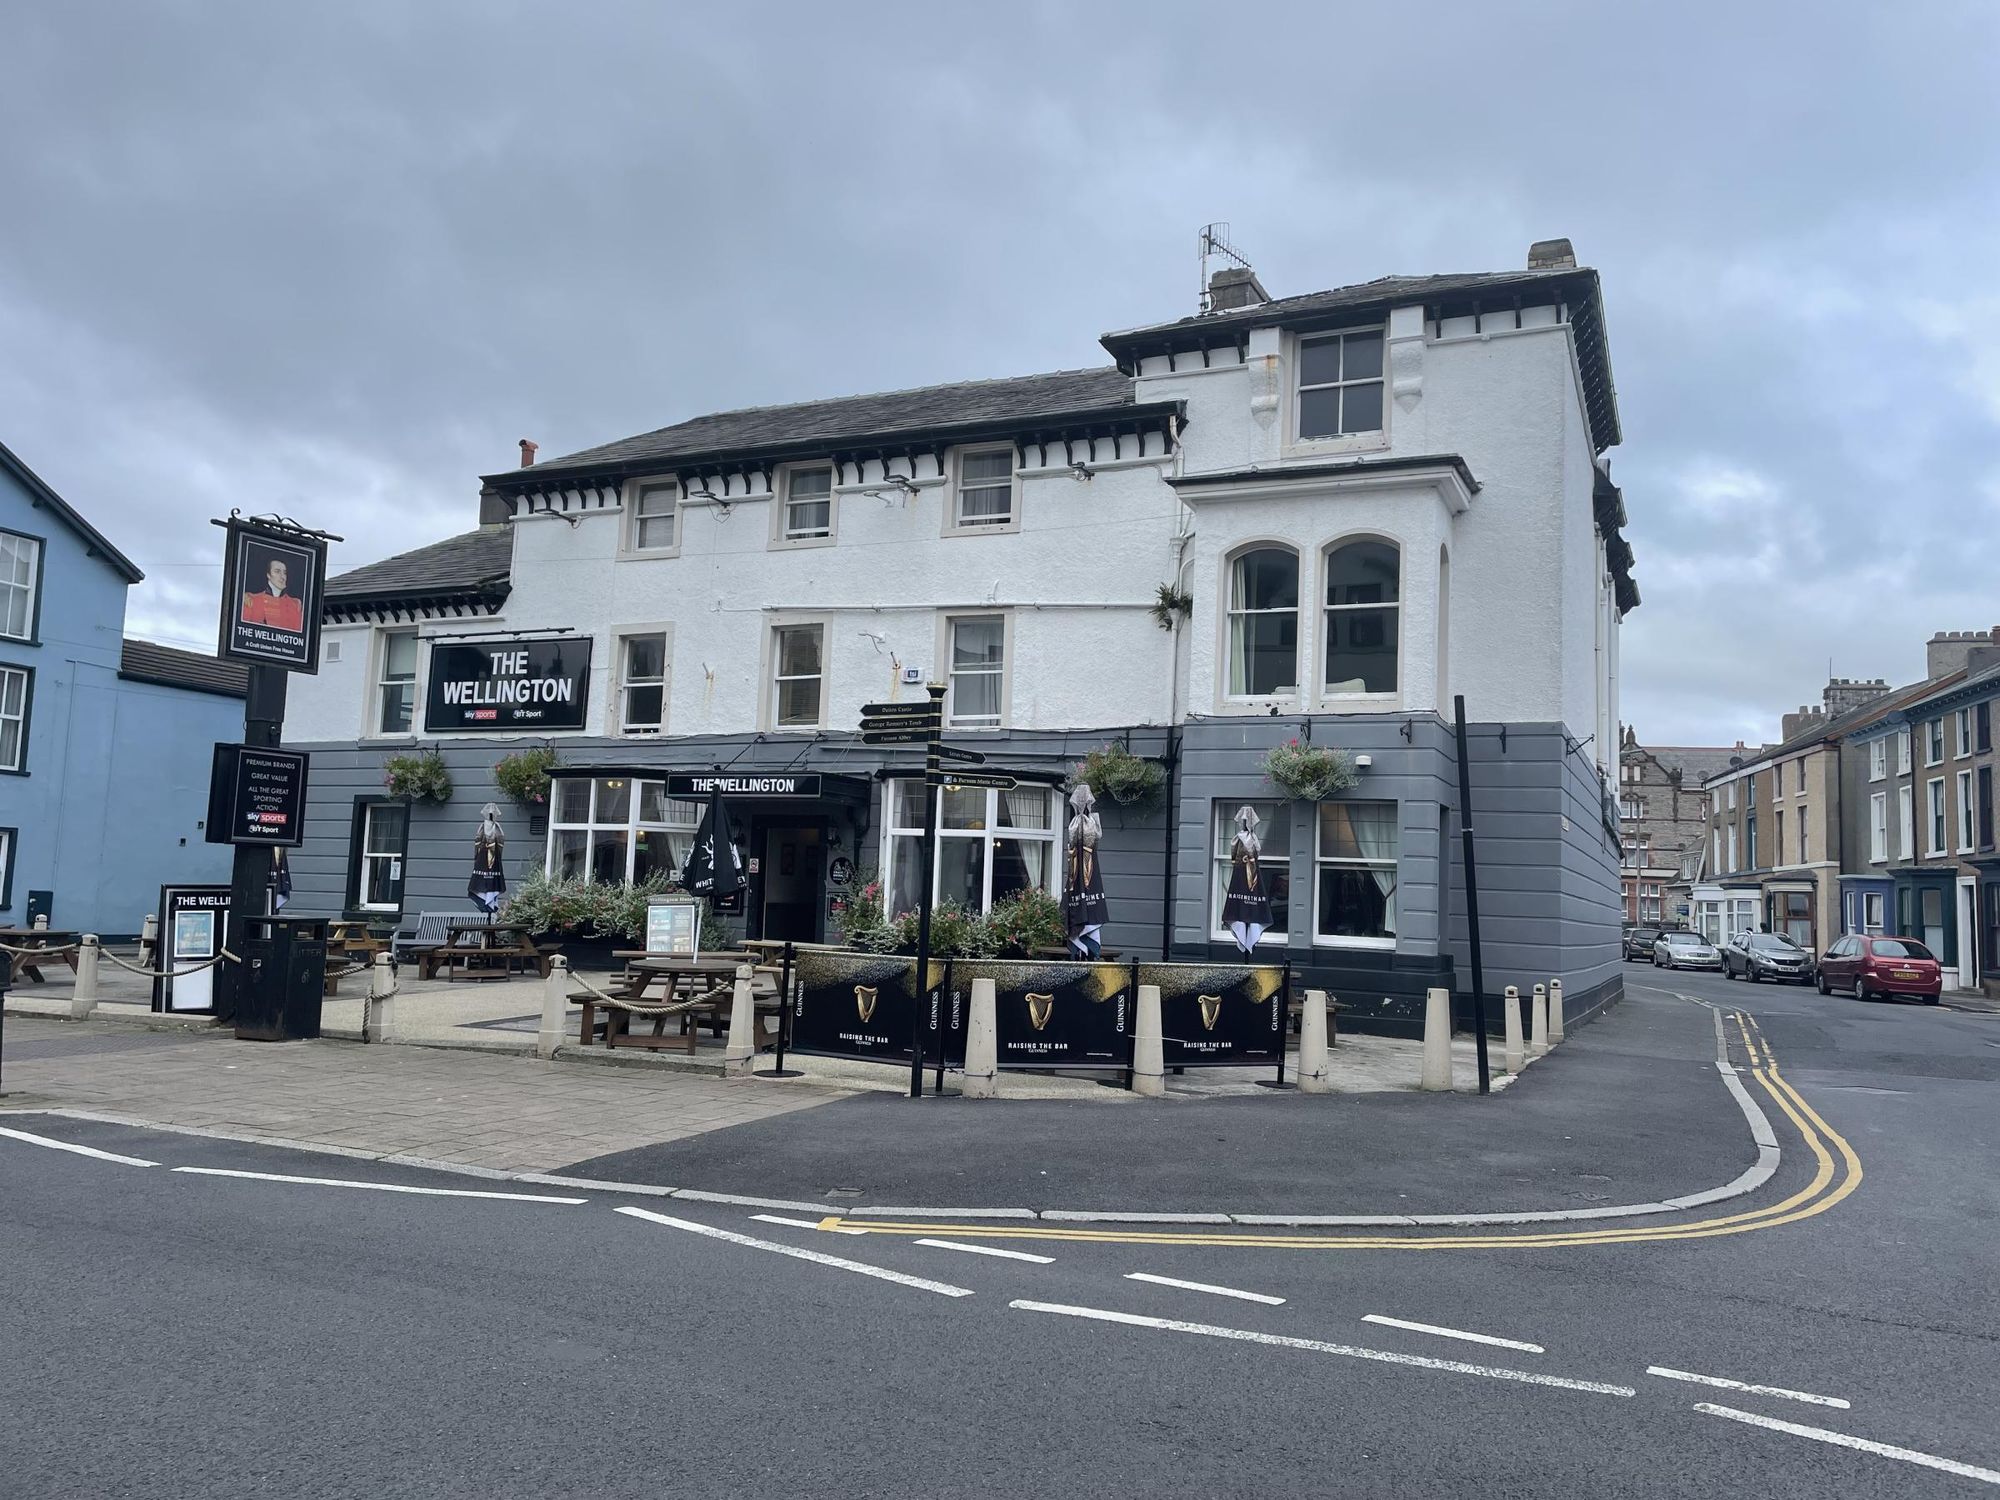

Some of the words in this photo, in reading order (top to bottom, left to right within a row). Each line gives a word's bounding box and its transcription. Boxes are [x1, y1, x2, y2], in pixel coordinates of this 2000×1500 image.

[237, 626, 253, 638] THE
[254, 629, 304, 647] WELLINGTON
[260, 643, 272, 651] Union
[490, 651, 529, 675] THE
[443, 678, 573, 704] WELLINGTON
[464, 710, 475, 720] sky
[475, 711, 496, 720] sports
[526, 710, 542, 718] Sport
[246, 758, 272, 768] PREMIUM
[272, 761, 296, 770] BRANDS
[251, 772, 270, 781] GREAT
[271, 774, 288, 782] VALUE
[248, 786, 259, 794] ALL
[259, 787, 271, 795] THE
[271, 788, 289, 796] GREAT
[691, 778, 715, 792] THE
[718, 778, 795, 793] WELLINGTON
[253, 795, 283, 803] SPORTING
[248, 813, 260, 822] sky
[262, 814, 285, 823] sports
[262, 826, 279, 834] Sport
[176, 896, 197, 906] THE
[796, 980, 804, 1017] GUINNESS
[930, 991, 939, 1030] GUINNESS
[951, 991, 960, 1030] GUINNESS
[1116, 994, 1125, 1032] GUINNESS
[1271, 996, 1279, 1031] GUINNESS
[839, 1032, 863, 1041] RAISING
